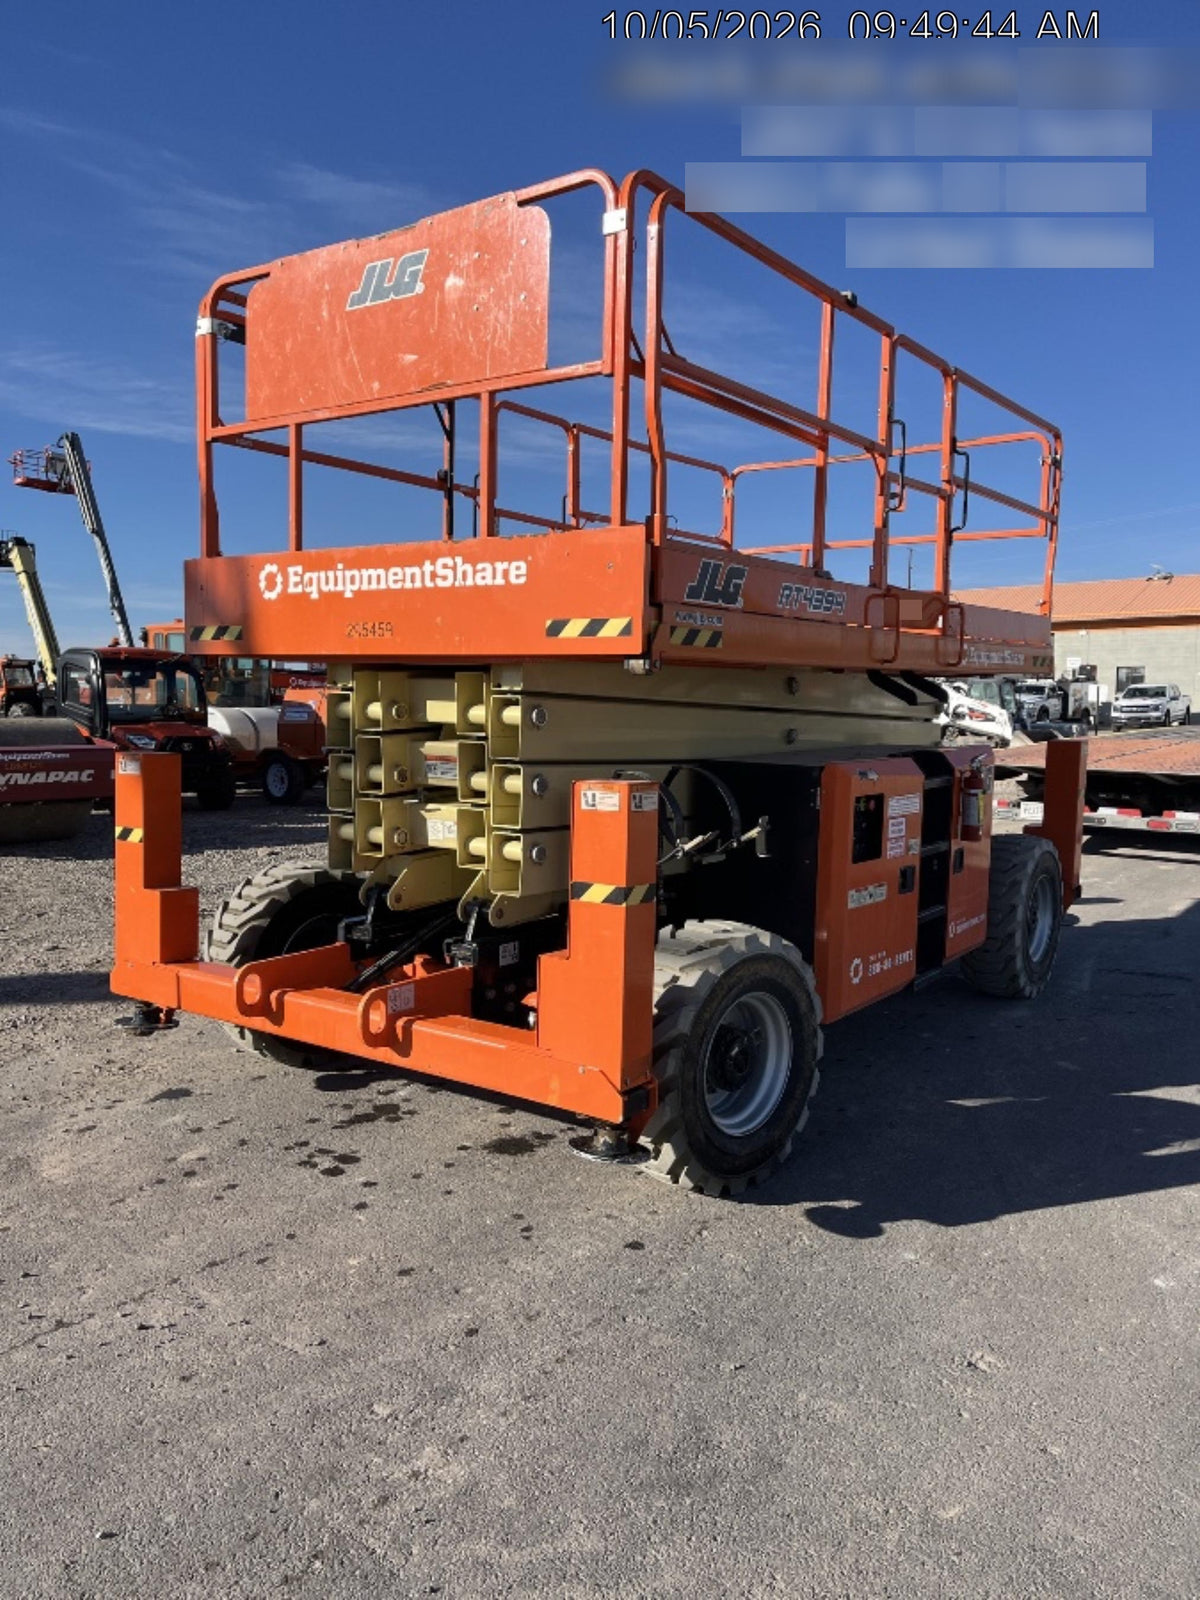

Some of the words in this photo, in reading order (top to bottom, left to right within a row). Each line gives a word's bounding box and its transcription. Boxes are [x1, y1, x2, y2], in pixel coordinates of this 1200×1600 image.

[345, 248, 430, 312] JLG
[286, 555, 528, 600] EquipmentShare
[684, 558, 749, 608] JLG
